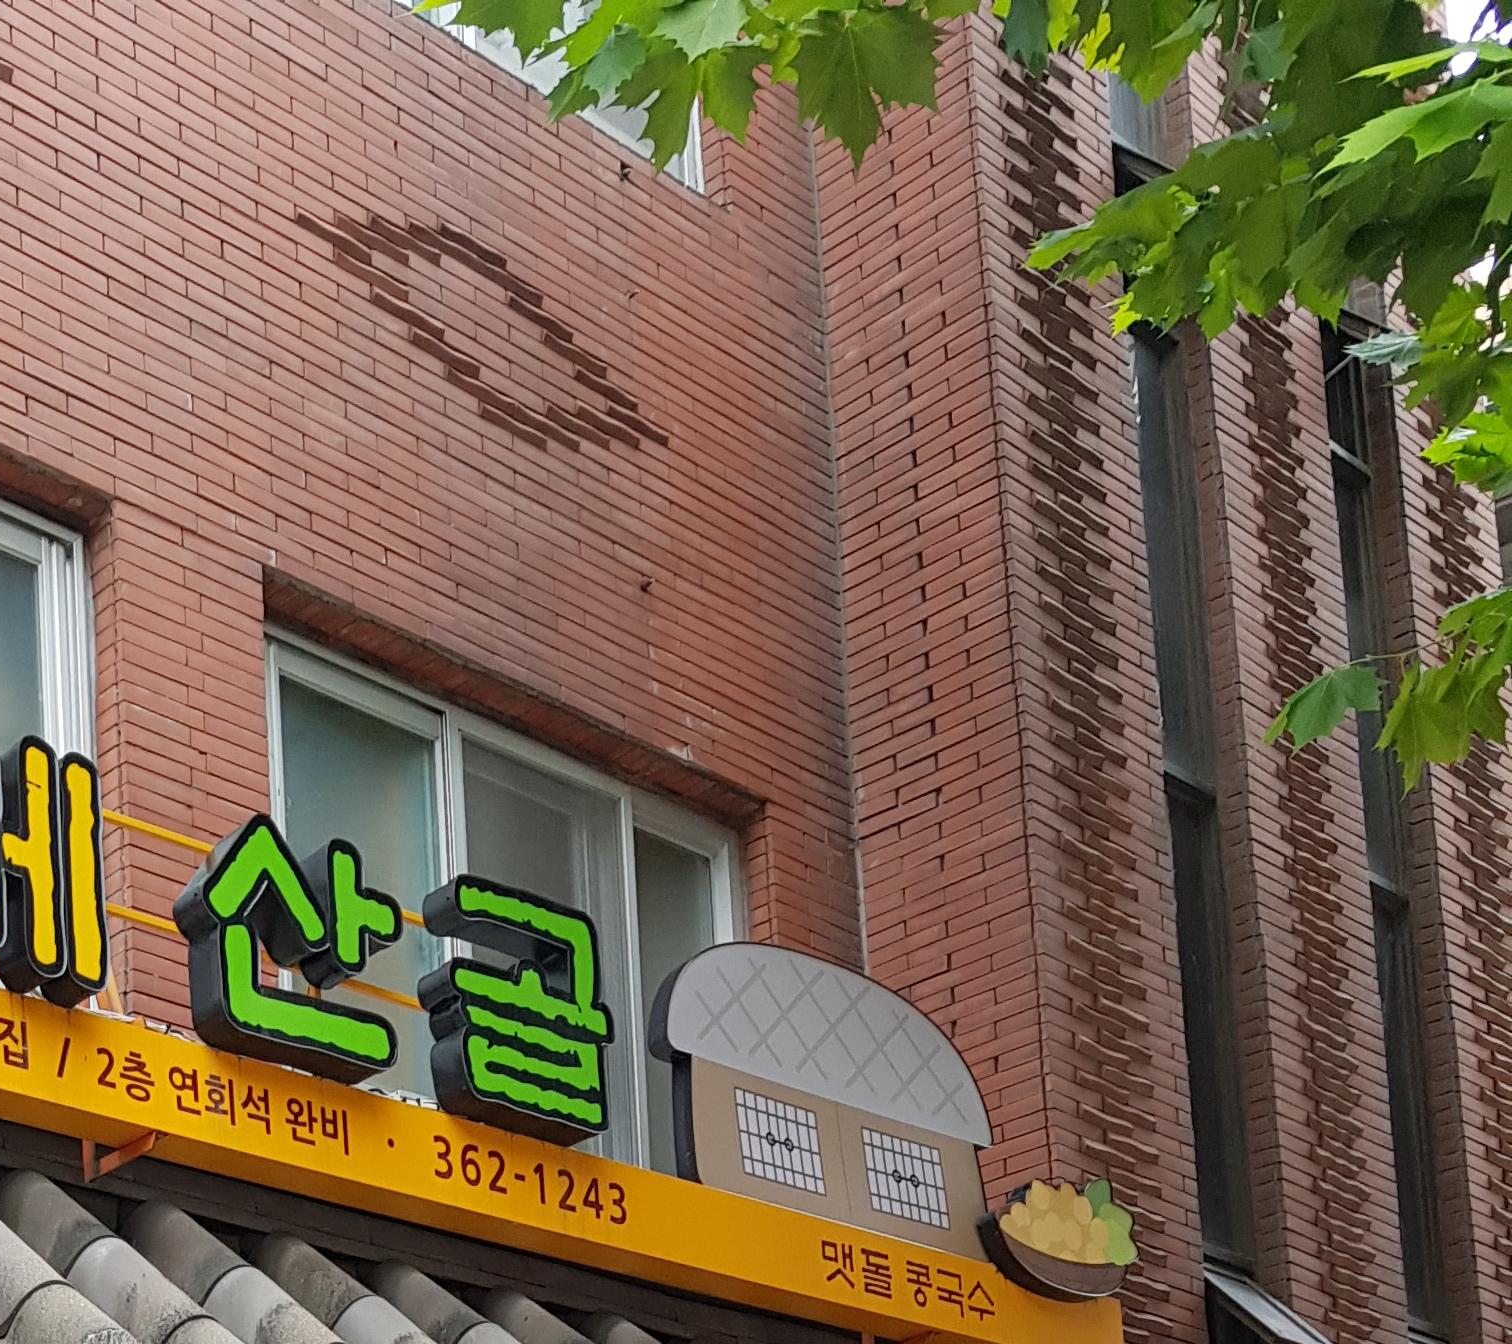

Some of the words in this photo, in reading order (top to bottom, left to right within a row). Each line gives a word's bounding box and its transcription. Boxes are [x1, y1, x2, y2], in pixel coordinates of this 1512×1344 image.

[96, 1047, 155, 1104] 2층
[168, 1063, 272, 1134] 연회석
[285, 1098, 350, 1155] 완비
[434, 1135, 628, 1226] 362-1243
[822, 1240, 893, 1299] 맷돌
[906, 1260, 996, 1321] 콩국수
